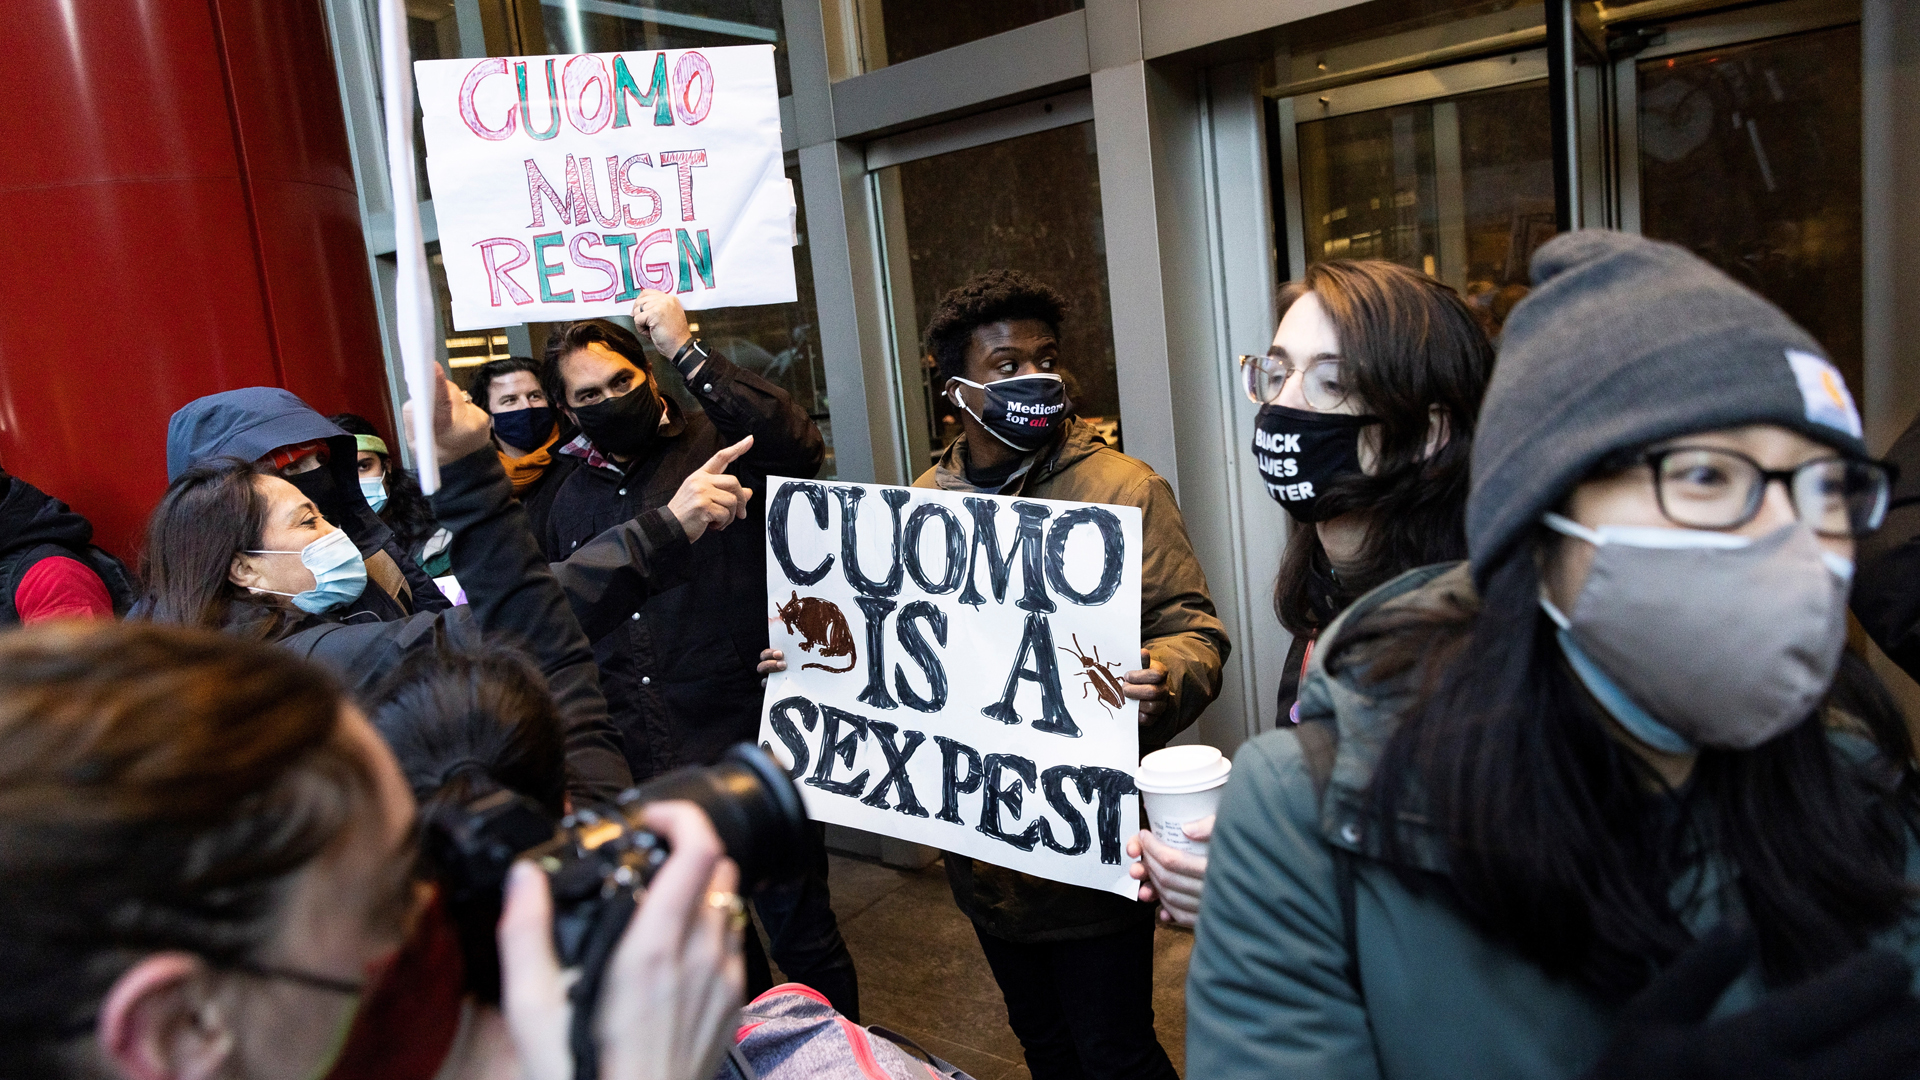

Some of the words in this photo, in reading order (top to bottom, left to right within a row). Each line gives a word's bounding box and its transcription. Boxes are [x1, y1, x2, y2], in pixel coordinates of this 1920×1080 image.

[459, 51, 714, 141] CUOMO
[524, 149, 708, 229] MUST
[472, 228, 715, 307] RESIGN
[1005, 412, 1028, 425] for
[1029, 417, 1049, 427] all.
[1255, 428, 1301, 453] BLACK
[1258, 452, 1299, 478] LIVES
[1264, 479, 1316, 501] TTER
[767, 481, 1125, 613] CUOMO
[854, 595, 948, 713] IS
[981, 611, 1082, 738] A
[762, 696, 929, 818] SEX
[933, 735, 1139, 865] PEST
